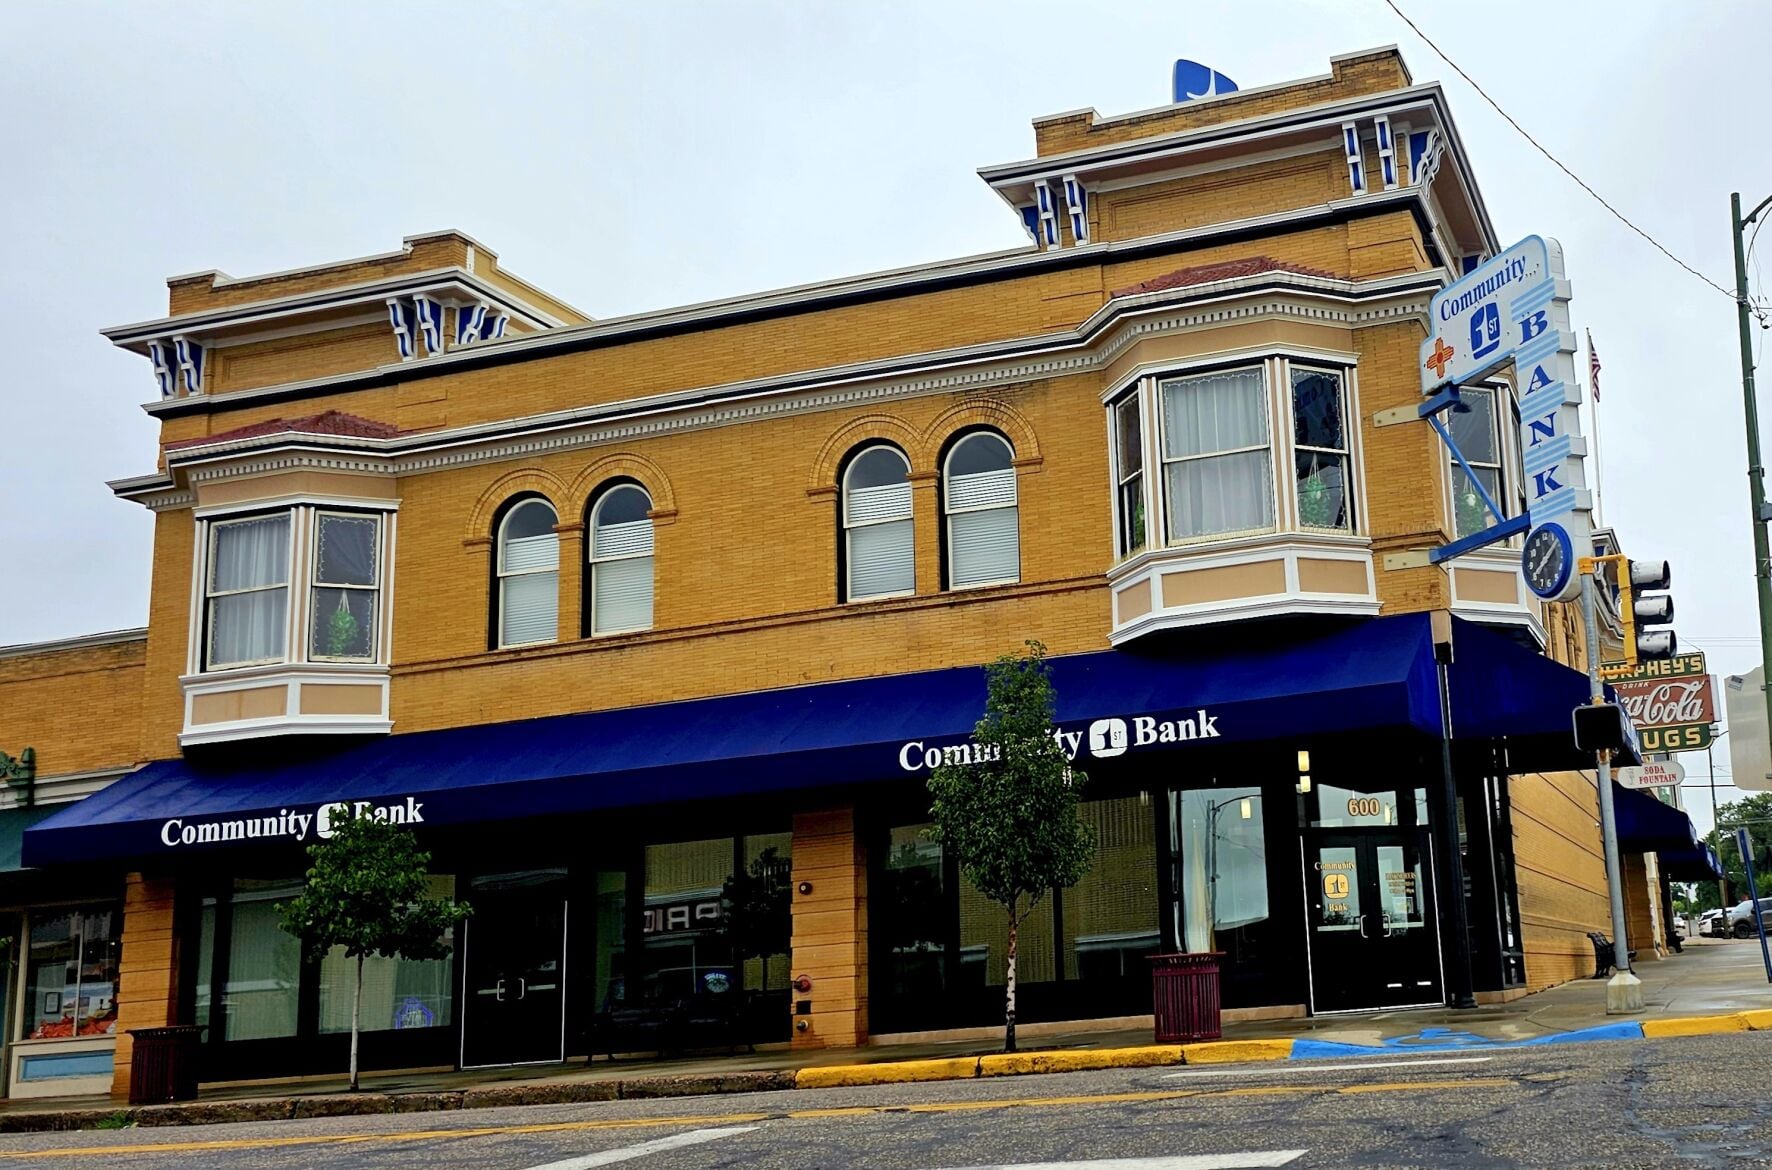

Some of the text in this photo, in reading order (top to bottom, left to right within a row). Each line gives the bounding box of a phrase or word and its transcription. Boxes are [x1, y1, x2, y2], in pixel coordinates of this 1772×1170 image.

[1441, 255, 1526, 321] Community
[1600, 656, 1703, 681] URPHEY'S
[1622, 681, 1650, 690] DRINK
[1132, 710, 1221, 746] Bank
[1643, 728, 1701, 749] UGS
[1644, 765, 1665, 775] SODA
[1639, 774, 1677, 785] FOUNTAIN
[1348, 798, 1380, 816] 600
[161, 808, 313, 846] Community
[1314, 861, 1355, 871] Community
[1329, 903, 1348, 912] Bank
